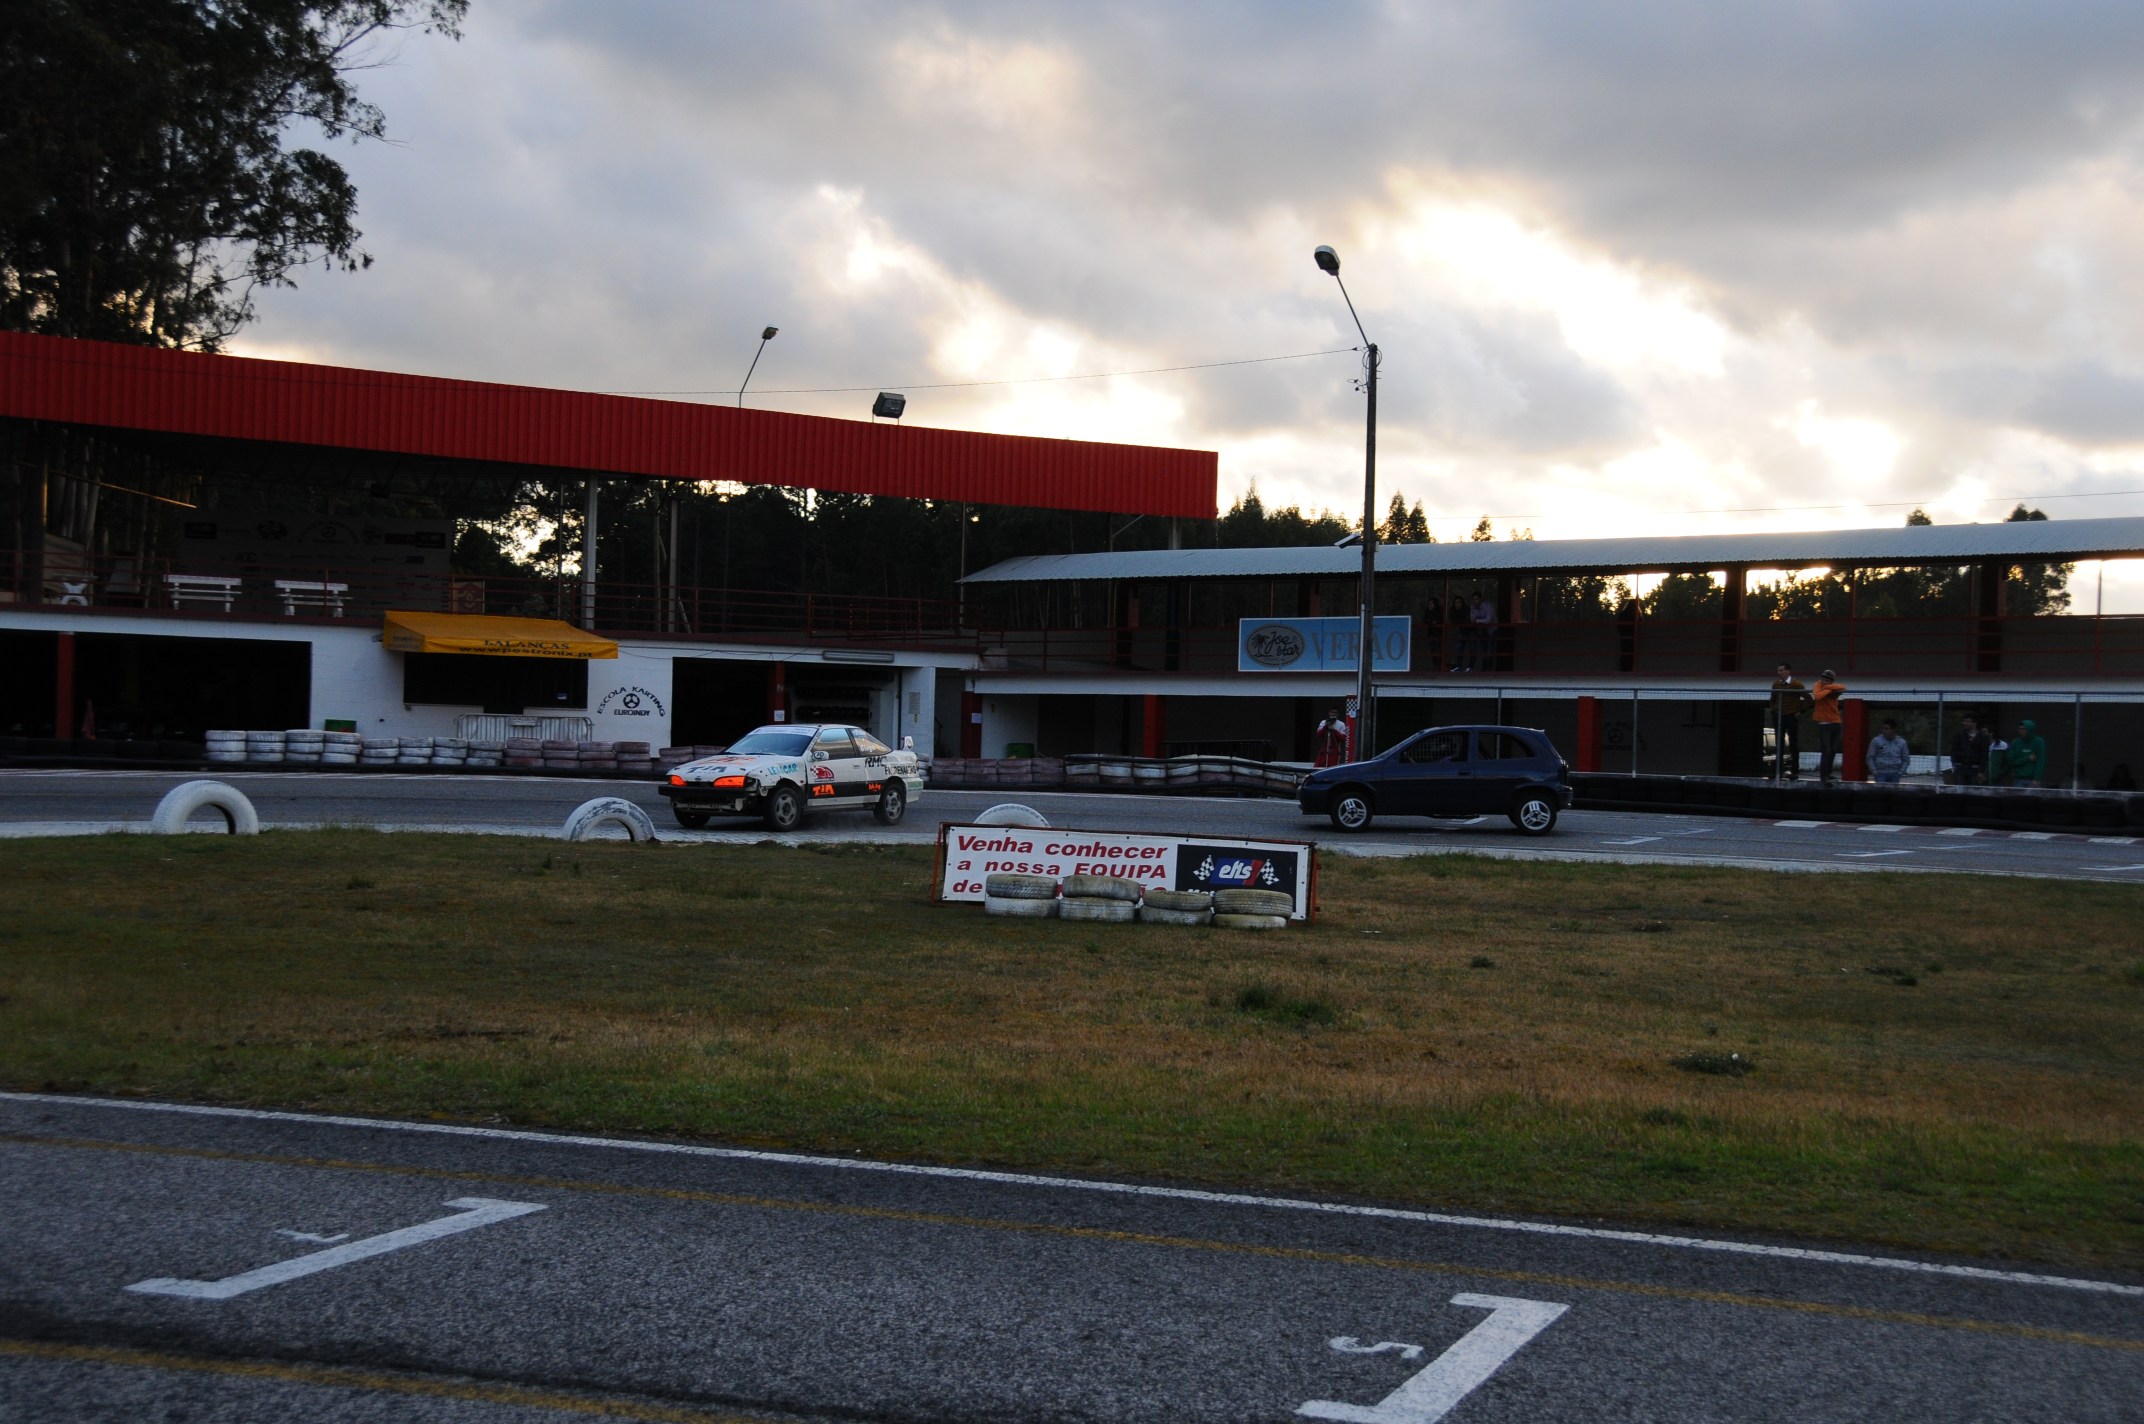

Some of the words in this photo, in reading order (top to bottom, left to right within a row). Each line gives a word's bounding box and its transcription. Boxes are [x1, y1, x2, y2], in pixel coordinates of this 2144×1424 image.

[1264, 631, 1292, 655] Joe
[597, 686, 627, 714] ESCOLA
[632, 686, 666, 717] KARTING
[958, 835, 1034, 854] Venha
[1045, 841, 1168, 859] conhecer
[957, 860, 971, 871] a
[985, 860, 1060, 876] nossa
[1074, 862, 1167, 879] EQUIPA
[953, 879, 983, 894] de
